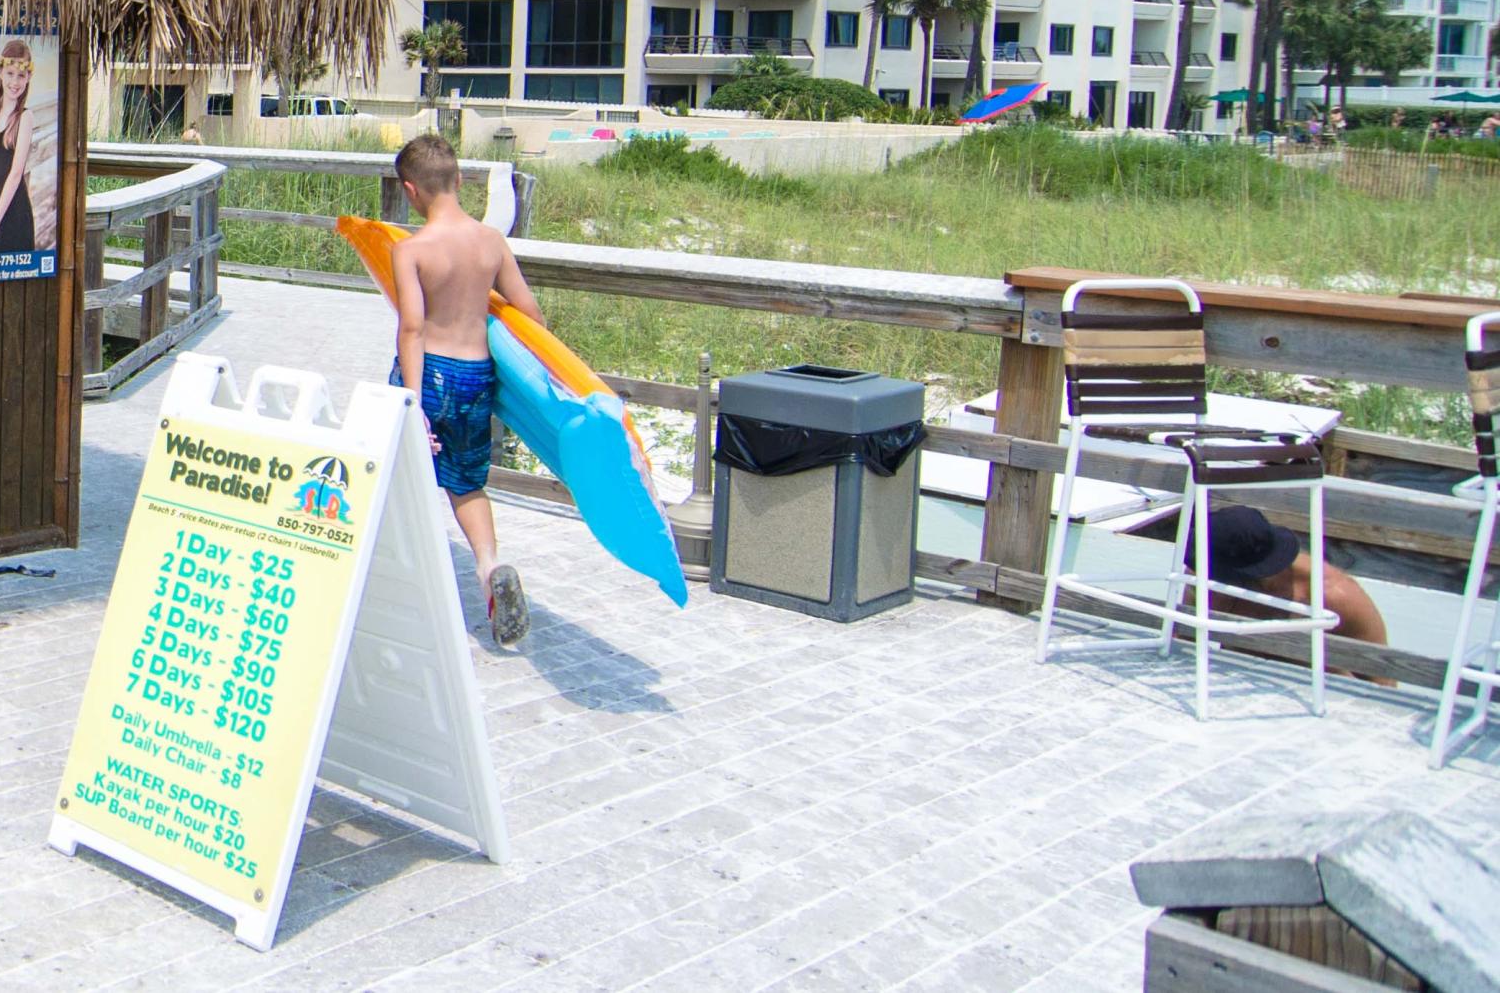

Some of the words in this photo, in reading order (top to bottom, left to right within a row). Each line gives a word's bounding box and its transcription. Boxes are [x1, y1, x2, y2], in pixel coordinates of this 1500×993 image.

[166, 432, 261, 474] Welcome
[268, 456, 293, 481] to
[169, 460, 272, 505] Paradise!
[170, 508, 198, 524] Srvice
[198, 516, 219, 530] Rates
[219, 522, 234, 535] per
[235, 524, 256, 540] setup
[267, 532, 292, 548] Chairs
[176, 530, 186, 550] 1
[187, 532, 232, 565] Day
[249, 549, 295, 581] $25
[277, 516, 354, 545] 850-797-0521
[154, 576, 169, 597] 3
[171, 581, 225, 616] Days
[243, 603, 289, 636] $60
[159, 551, 175, 573] 2
[177, 556, 232, 590] Days
[250, 577, 296, 609] $40
[141, 625, 157, 646] 5
[159, 630, 212, 666] Days
[231, 655, 276, 688] $90
[148, 602, 163, 622] 4
[166, 606, 220, 642] Days
[238, 629, 283, 661] $75
[126, 672, 140, 692] 7
[142, 678, 195, 716] Days
[213, 705, 266, 742] $120
[131, 648, 146, 669] 6
[149, 654, 202, 690] Days
[220, 679, 274, 716] $105
[111, 703, 150, 733] Daily
[154, 721, 222, 760] Umbrella
[235, 753, 264, 777] $12
[121, 728, 161, 757] Daily
[165, 746, 207, 774] Chair
[220, 768, 242, 790] $8
[94, 771, 142, 805] Kayak
[144, 797, 170, 817] per
[173, 807, 209, 836] hour
[212, 824, 245, 851] $20
[107, 755, 165, 794] WATER
[168, 783, 243, 829] SPORTS:
[74, 782, 107, 807] SUP
[108, 798, 154, 830] Board
[154, 823, 181, 843] per
[183, 833, 220, 862] hour
[223, 851, 258, 879] $25
